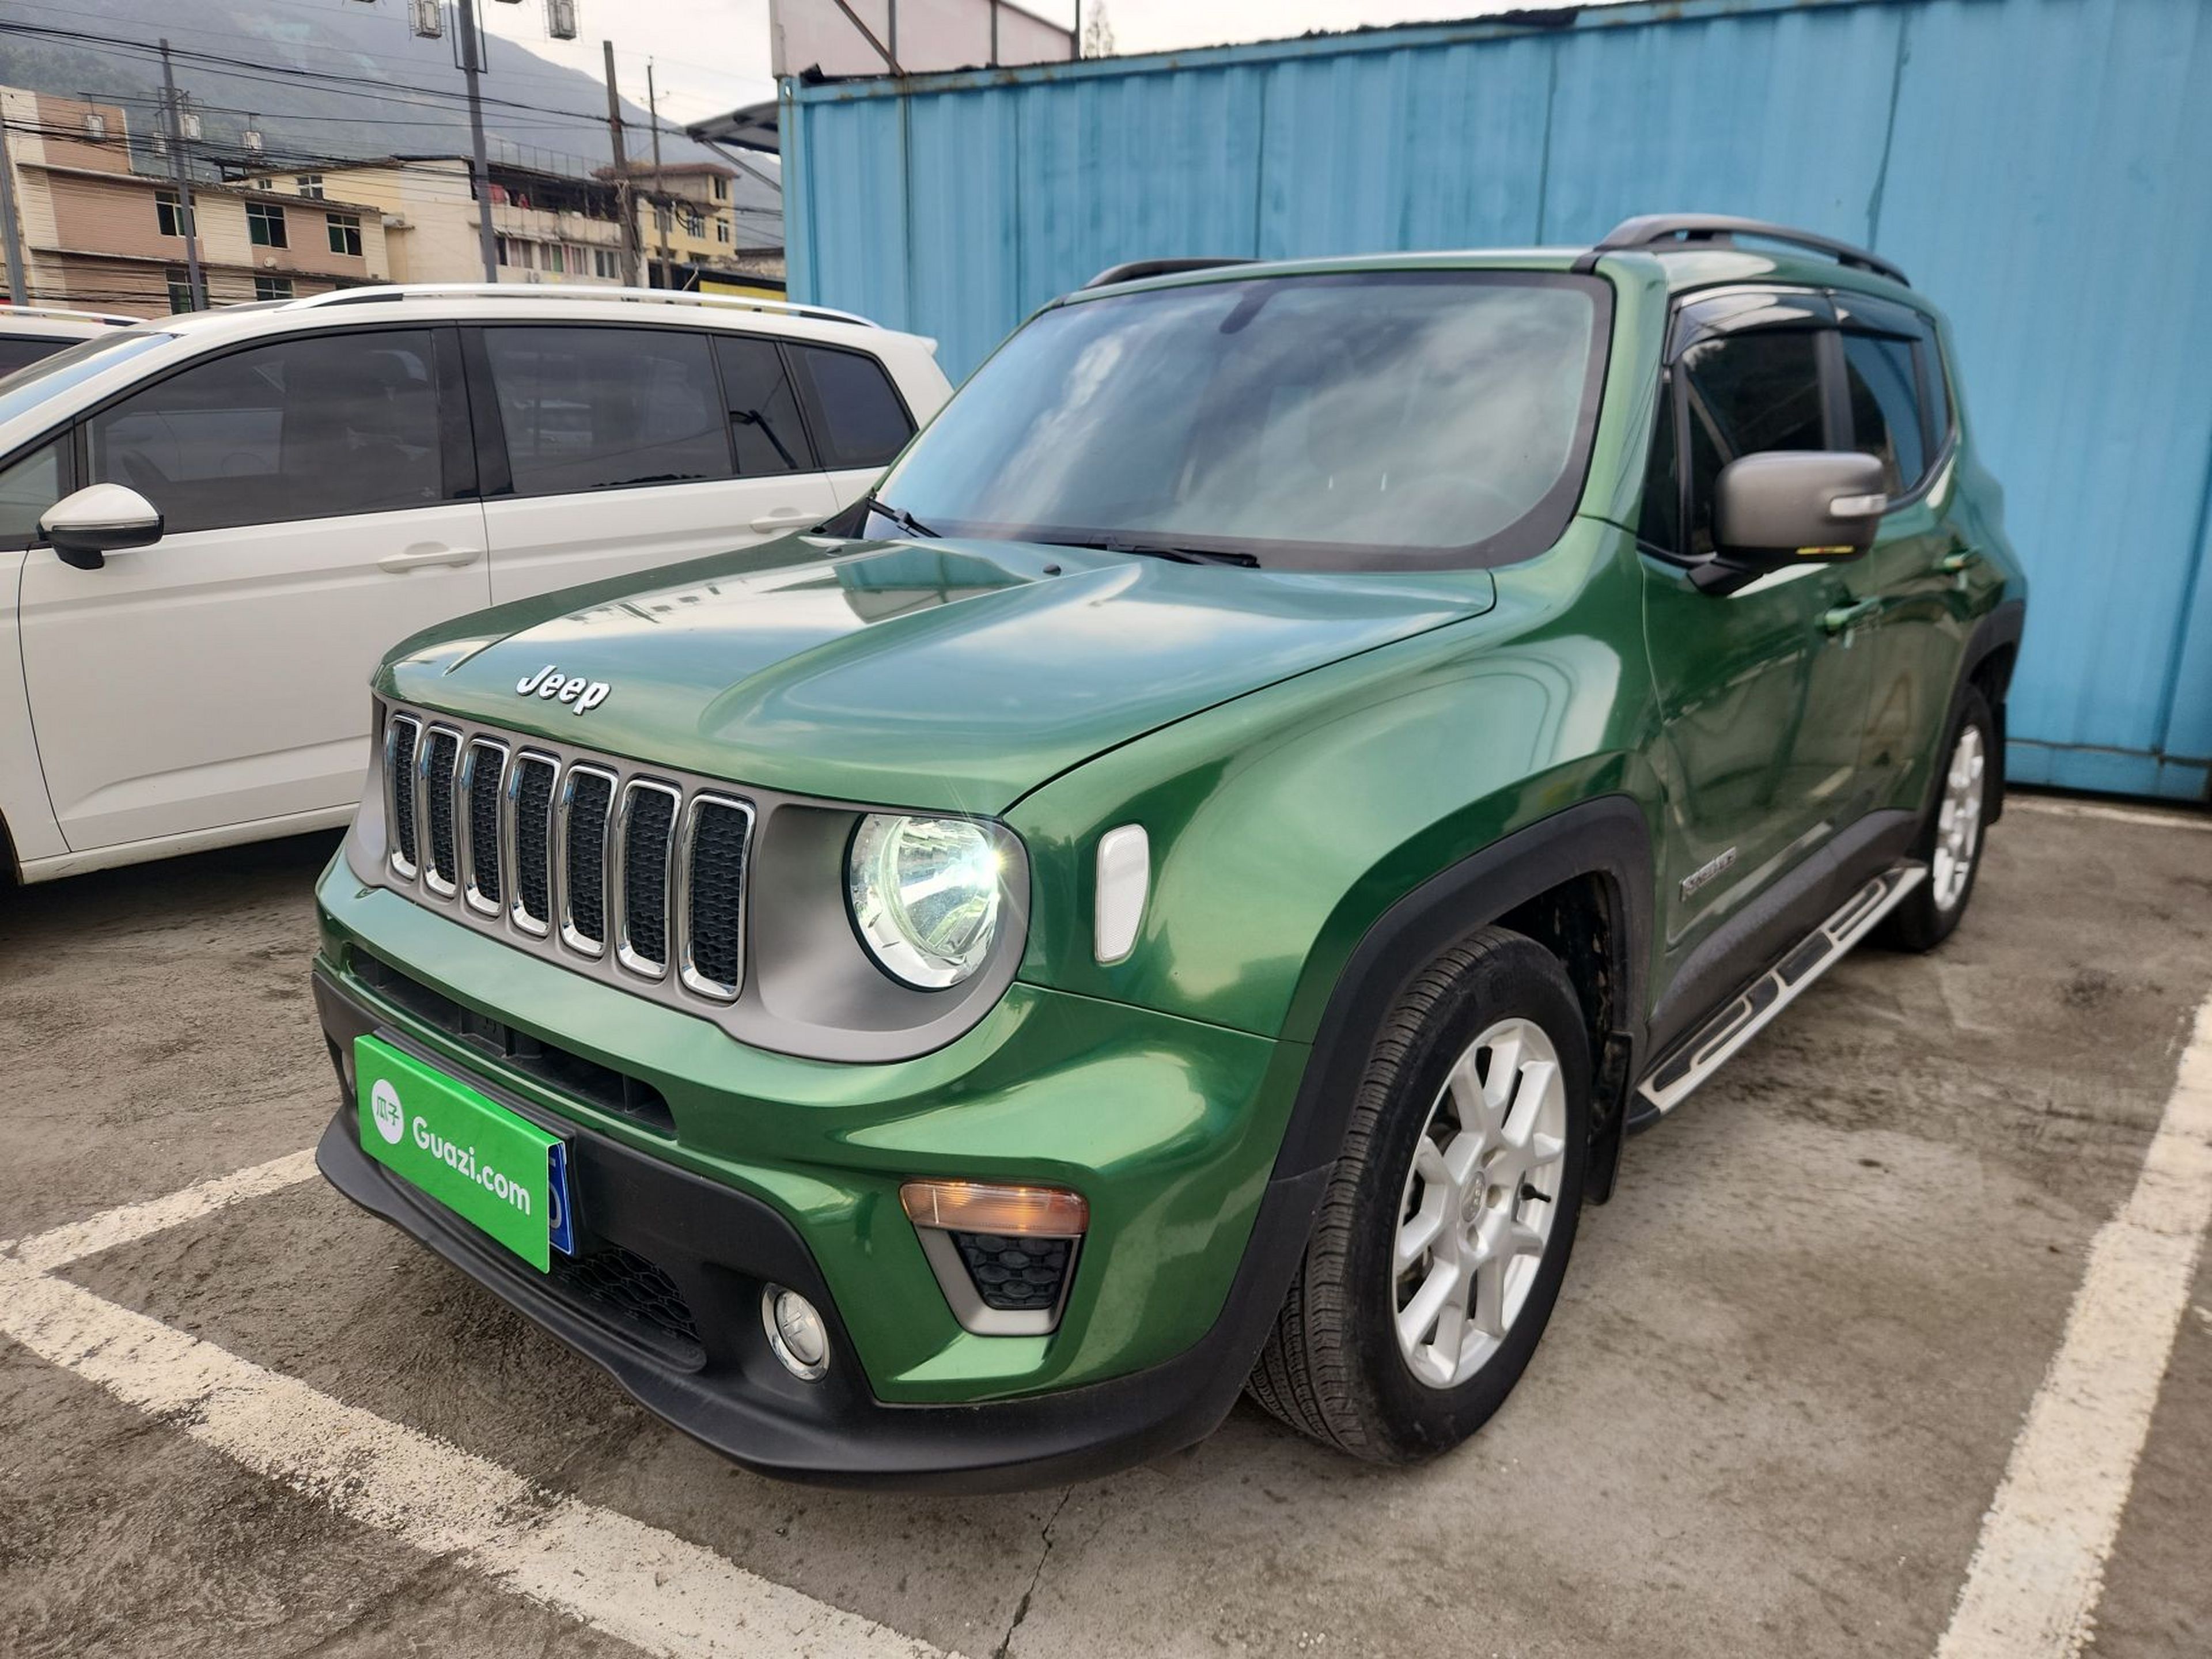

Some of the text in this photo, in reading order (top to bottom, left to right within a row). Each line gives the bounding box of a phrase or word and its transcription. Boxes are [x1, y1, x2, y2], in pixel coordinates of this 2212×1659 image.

[516, 664, 611, 715] Jeep
[377, 1095, 400, 1126] 瓜子
[412, 1116, 531, 1215] Guazi.com
